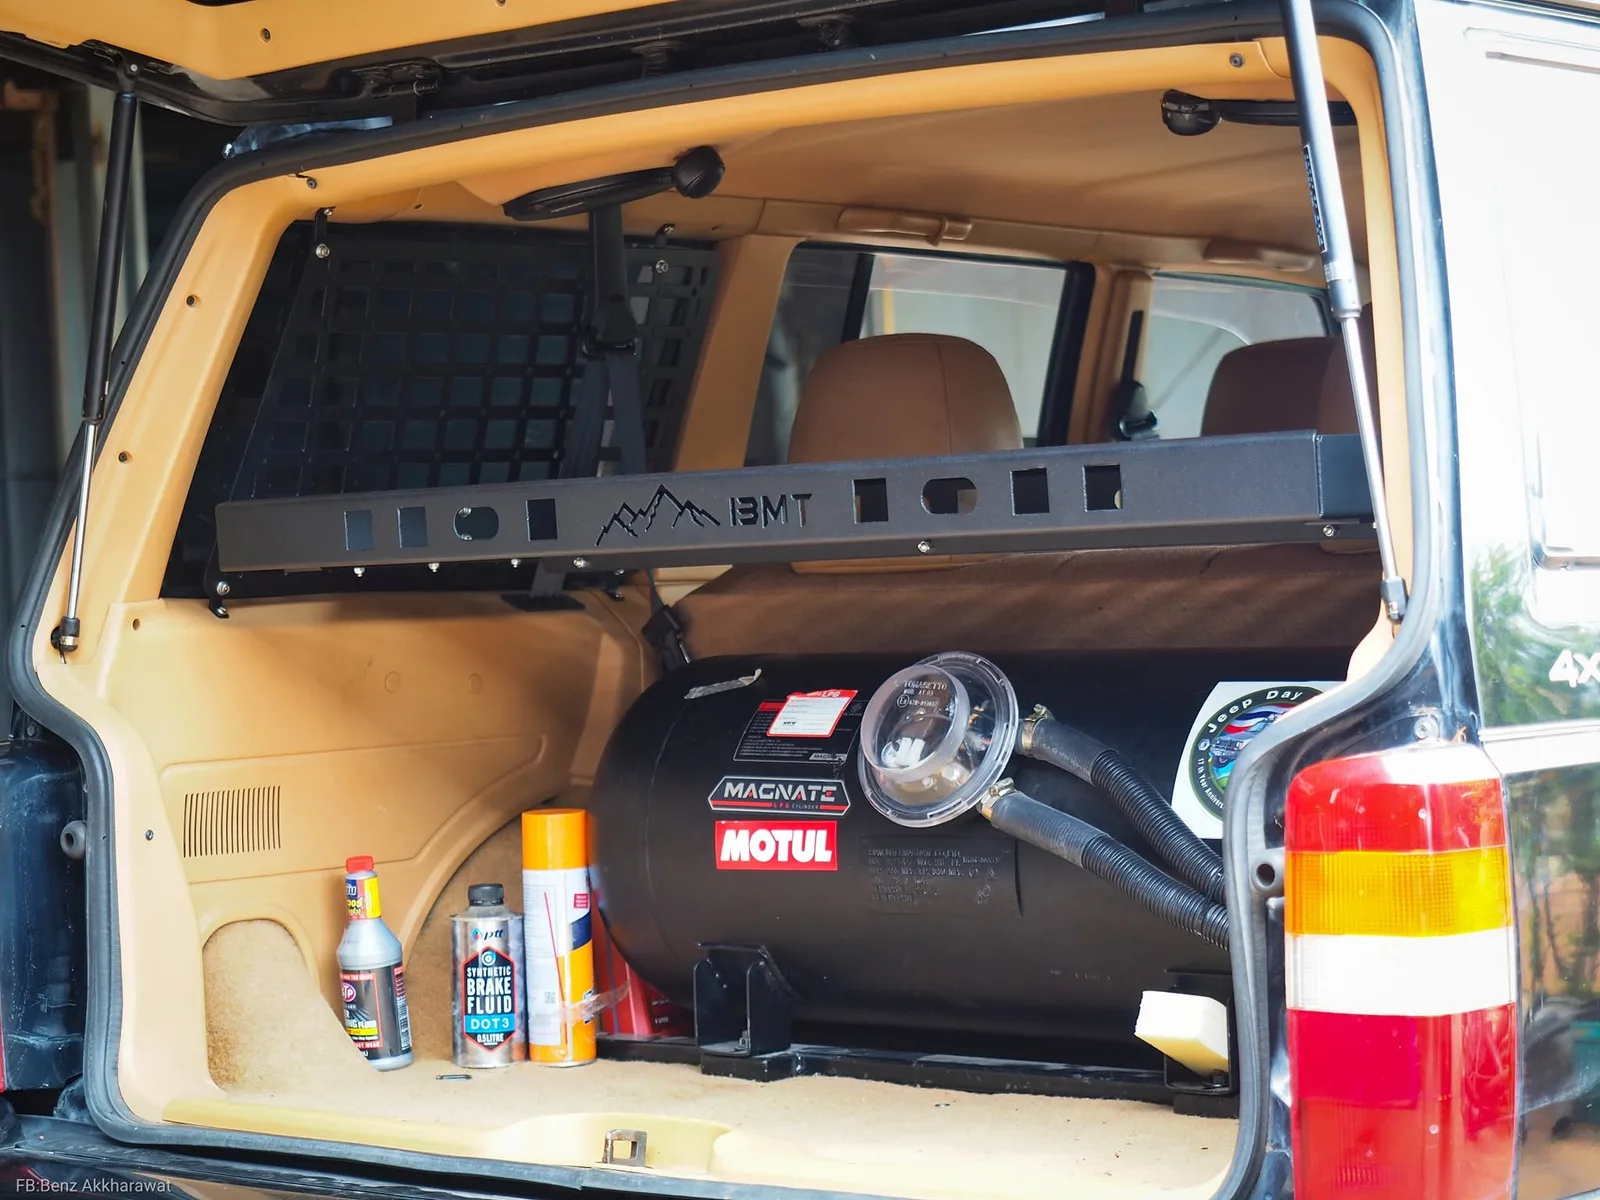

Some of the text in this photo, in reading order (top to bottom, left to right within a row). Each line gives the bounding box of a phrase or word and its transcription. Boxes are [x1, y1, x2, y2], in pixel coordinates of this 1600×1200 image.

[1207, 690, 1303, 733] Jeep Day
[1199, 773, 1208, 789] Year
[724, 782, 837, 802] MAGNATE
[720, 828, 833, 863] MOTUL
[484, 928, 504, 940] ptt
[466, 966, 511, 978] SYNTHETIC
[467, 977, 512, 996] BRAKE
[467, 995, 512, 1015] FLUID
[470, 1017, 510, 1030] DOT 3
